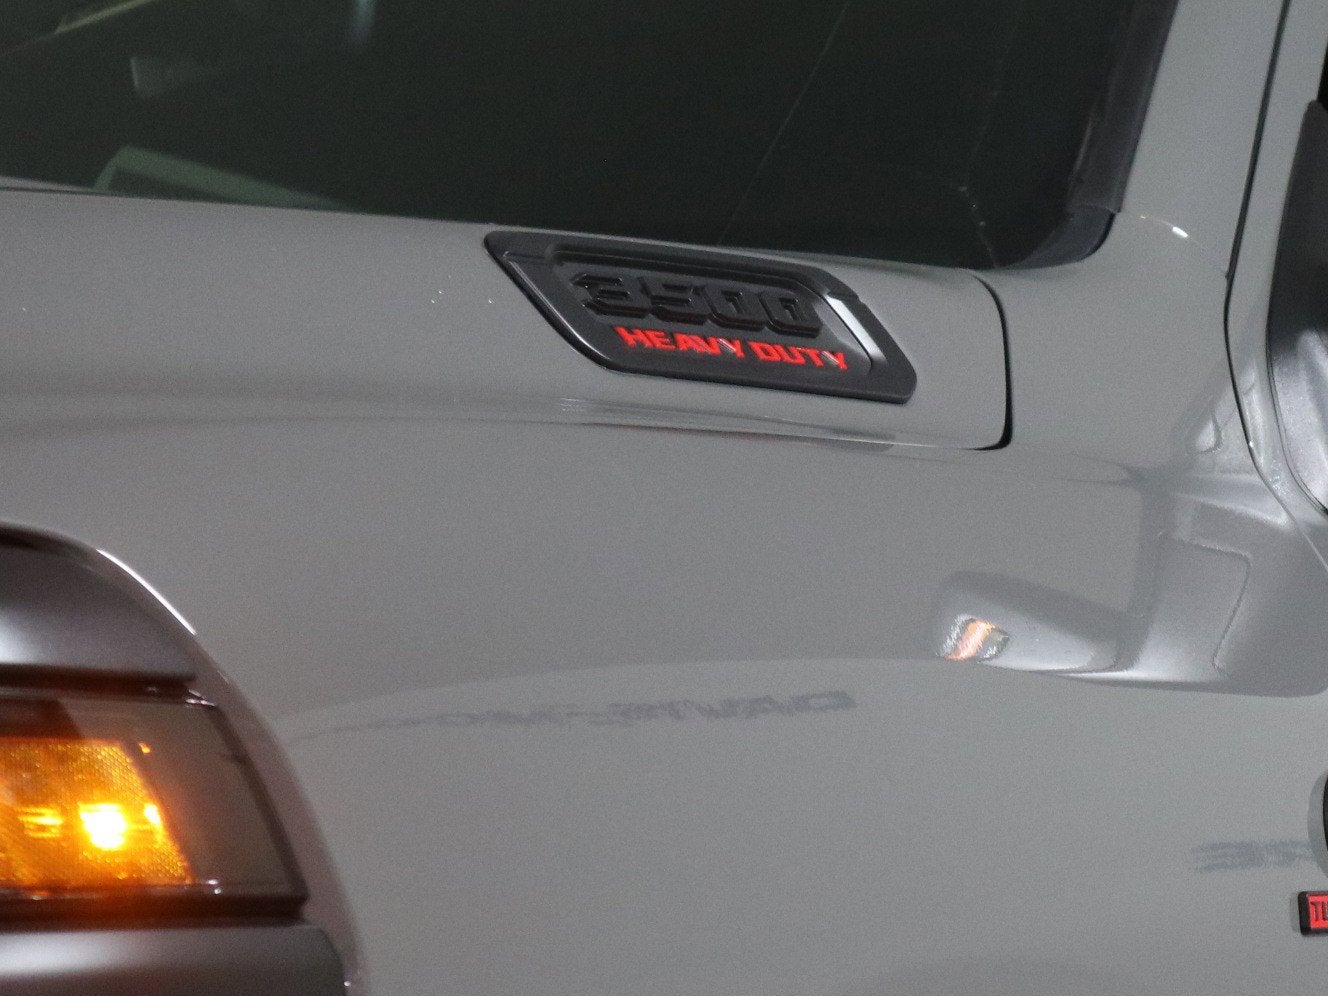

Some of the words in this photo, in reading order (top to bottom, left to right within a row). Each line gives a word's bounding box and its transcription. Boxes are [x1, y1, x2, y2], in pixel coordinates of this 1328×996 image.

[572, 274, 822, 337] 3500
[614, 326, 745, 359] HEAVY
[751, 342, 848, 370] DUTY
